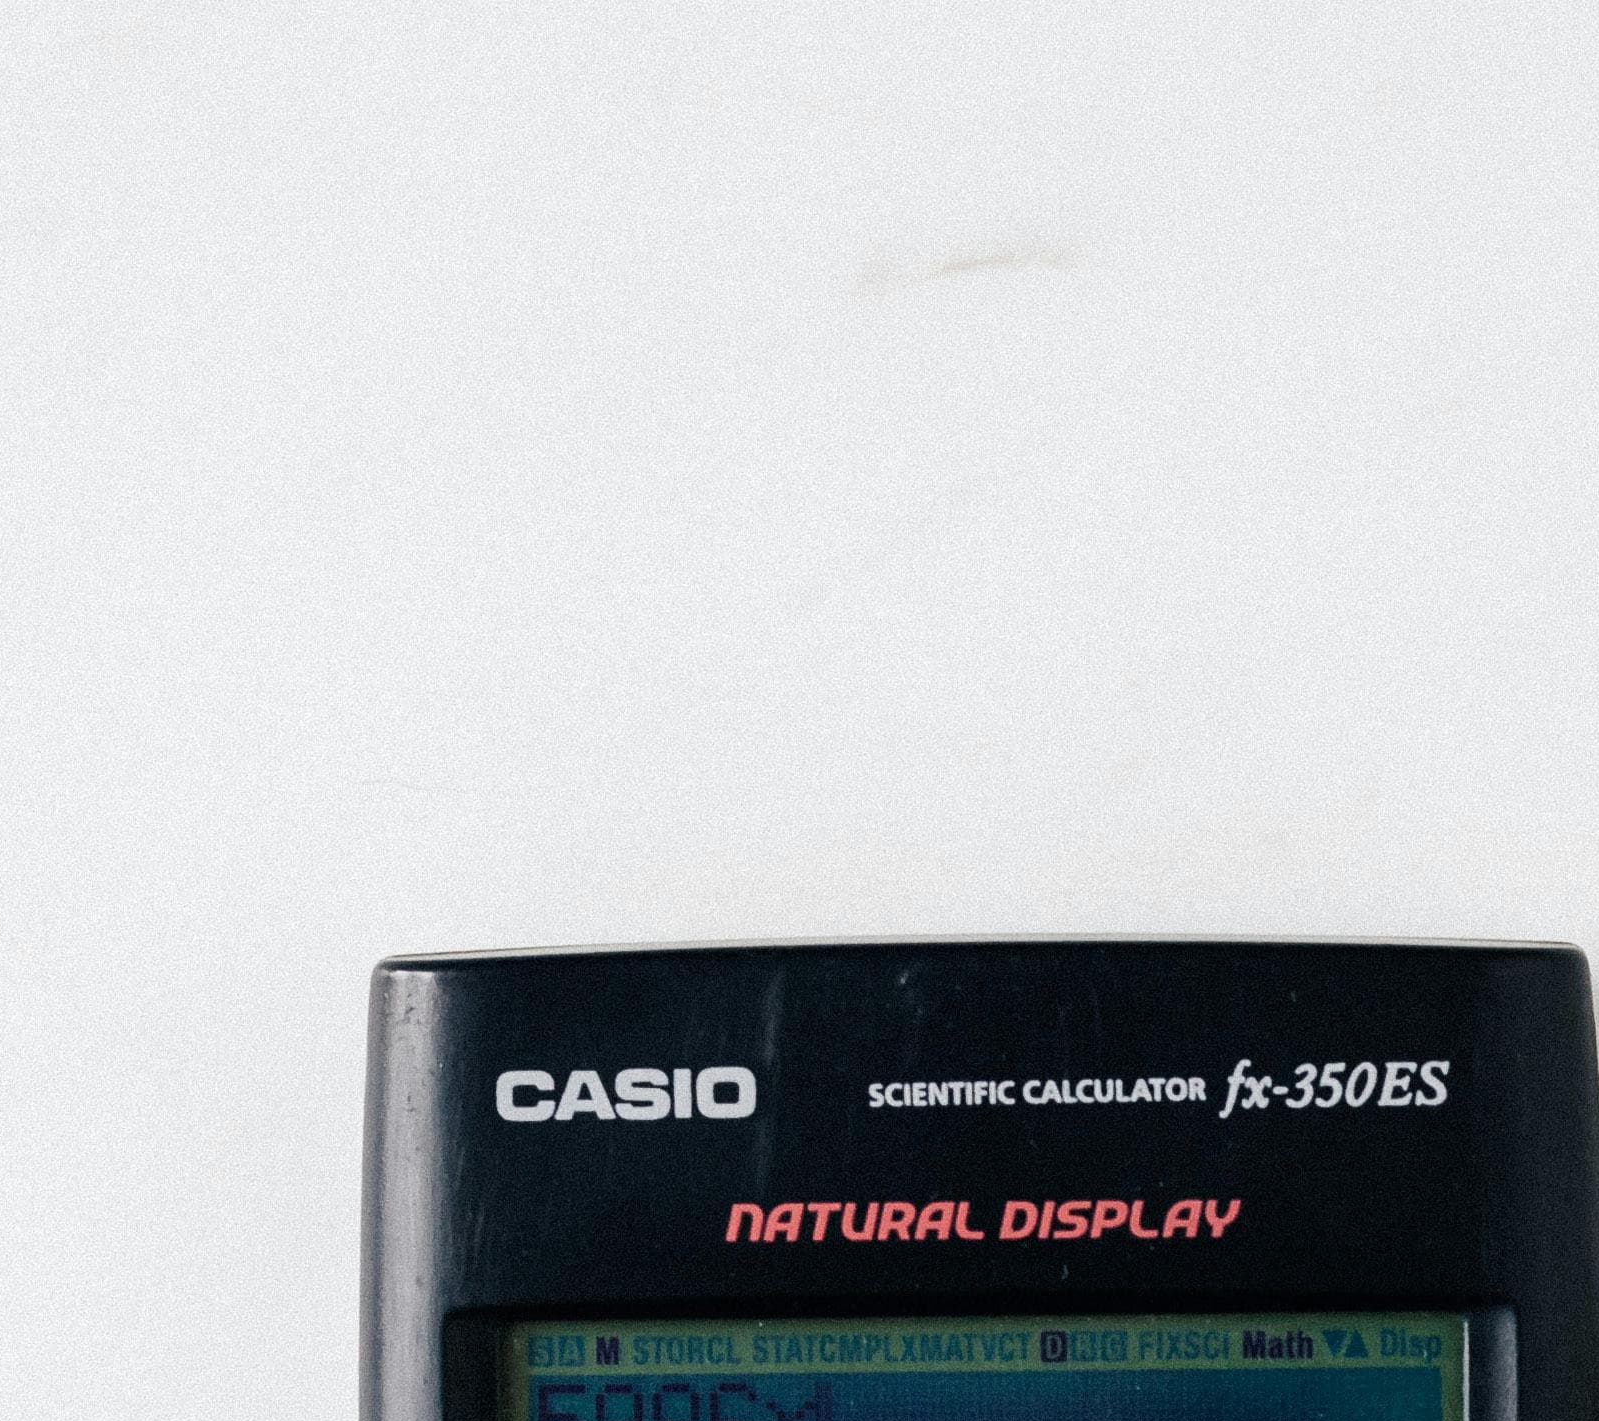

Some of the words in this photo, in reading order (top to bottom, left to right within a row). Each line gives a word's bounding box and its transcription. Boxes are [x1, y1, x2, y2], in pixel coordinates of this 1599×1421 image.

[496, 1067, 756, 1122] CASIO
[869, 1081, 1015, 1107] SCIENTIFIC
[1023, 1077, 1206, 1104] CALCULATOR
[1219, 1059, 1449, 1118] fx-350ES
[726, 1202, 984, 1242] NATURAL
[1000, 1200, 1240, 1239] DISPLAY
[1242, 1329, 1313, 1361] Math
